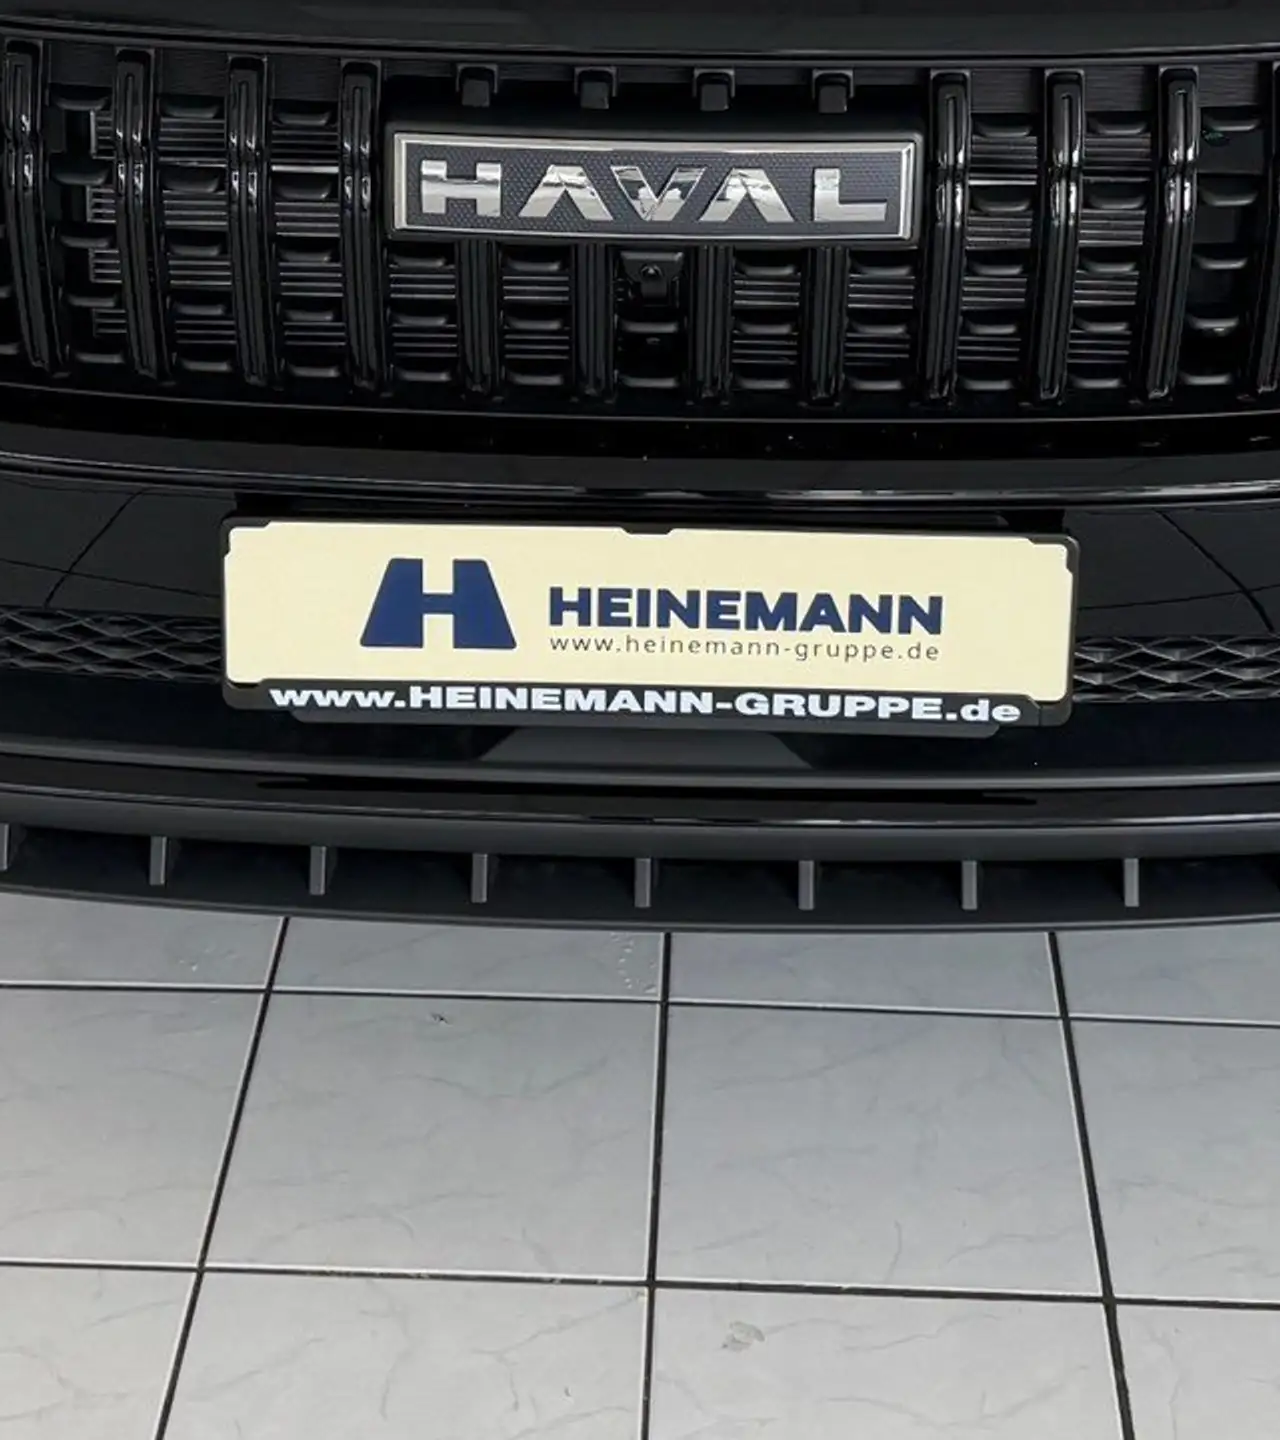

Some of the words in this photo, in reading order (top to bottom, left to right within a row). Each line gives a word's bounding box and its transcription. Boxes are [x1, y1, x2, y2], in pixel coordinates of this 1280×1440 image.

[420, 160, 887, 222] HAVAL
[549, 586, 943, 635] HEINEMANN
[550, 634, 941, 663] www.heinemann-gruppe.de
[269, 685, 1022, 722] www.HEINEMANN-GRUPPE.de
